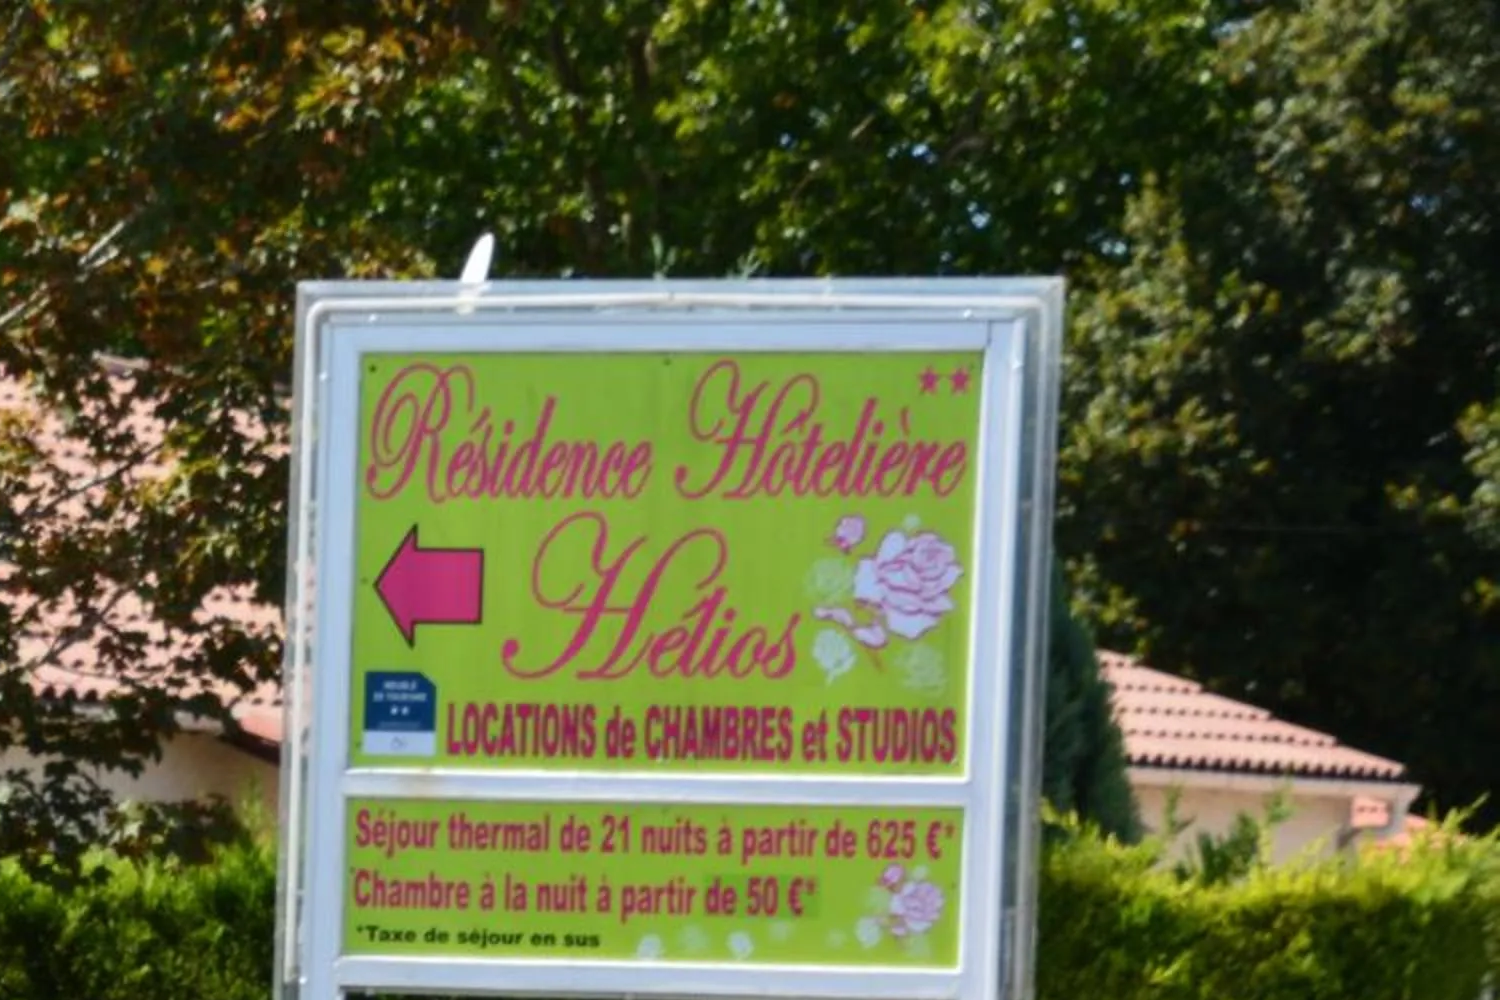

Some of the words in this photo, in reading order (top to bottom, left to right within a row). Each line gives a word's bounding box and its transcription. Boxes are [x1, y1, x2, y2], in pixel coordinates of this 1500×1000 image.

[366, 363, 652, 502] Résidence
[674, 359, 967, 500] Hôtelière
[503, 511, 801, 681] Hélios
[446, 702, 596, 757] LOCATIONS
[605, 705, 636, 759] de
[644, 704, 793, 762] CHAMBRES
[802, 708, 829, 762] et
[836, 706, 957, 763] STUDIOS
[355, 808, 440, 860] Séjour
[447, 812, 550, 852] thermal
[559, 814, 591, 853] de
[602, 814, 631, 853] 21
[641, 817, 708, 855] nuits
[717, 817, 733, 855] à
[741, 818, 819, 867] partir
[825, 819, 857, 858] de
[866, 820, 916, 859] 625
[354, 868, 470, 910] Chambre
[480, 873, 495, 911] à
[504, 872, 528, 912] la
[536, 874, 588, 913] nuit
[596, 876, 612, 914] à
[620, 876, 697, 925] partir
[705, 878, 737, 917] de
[746, 876, 779, 916] 50
[424, 927, 449, 945] de
[457, 928, 523, 949] séjour
[530, 932, 556, 948] en
[563, 932, 600, 948] sus
